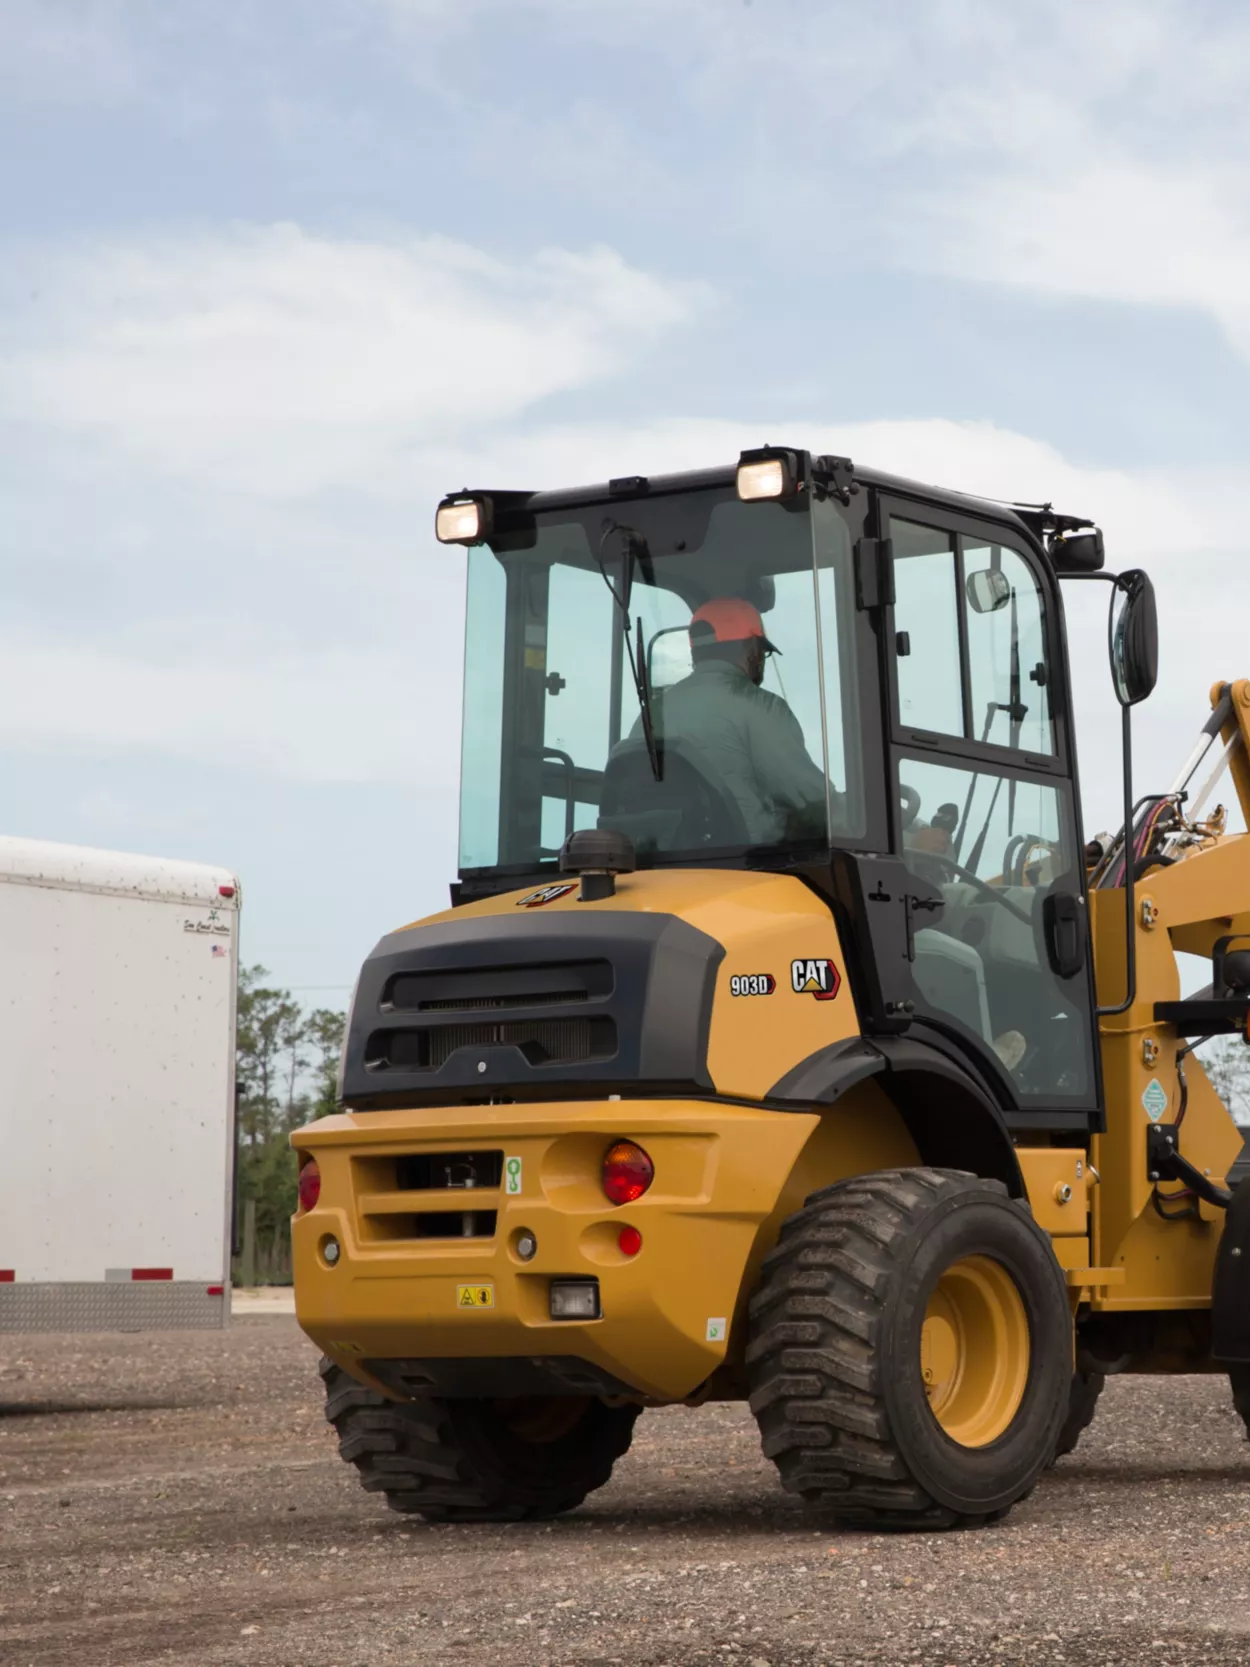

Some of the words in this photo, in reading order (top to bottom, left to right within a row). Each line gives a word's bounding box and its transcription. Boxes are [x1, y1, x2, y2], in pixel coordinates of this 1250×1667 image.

[518, 886, 573, 904] CAT
[731, 975, 769, 996] 903D
[792, 959, 829, 992] CAT
